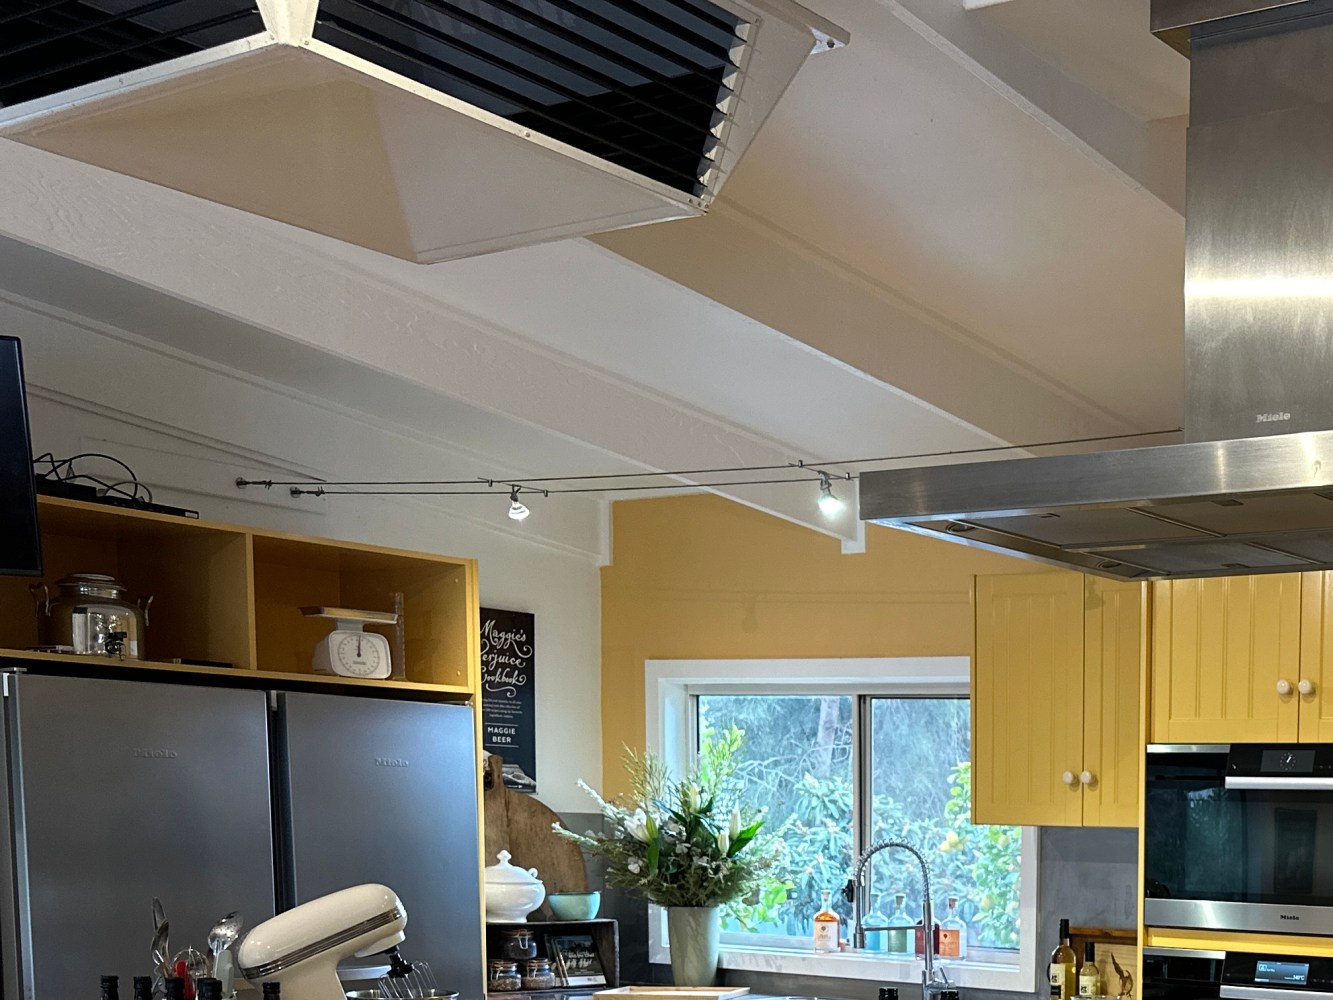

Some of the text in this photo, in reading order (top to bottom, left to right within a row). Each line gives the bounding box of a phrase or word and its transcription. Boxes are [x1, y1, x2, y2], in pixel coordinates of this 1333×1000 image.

[1256, 412, 1291, 423] Miele
[480, 619, 533, 658] Maggie's
[487, 726, 516, 735] MAGGIE
[492, 735, 512, 744] BEER
